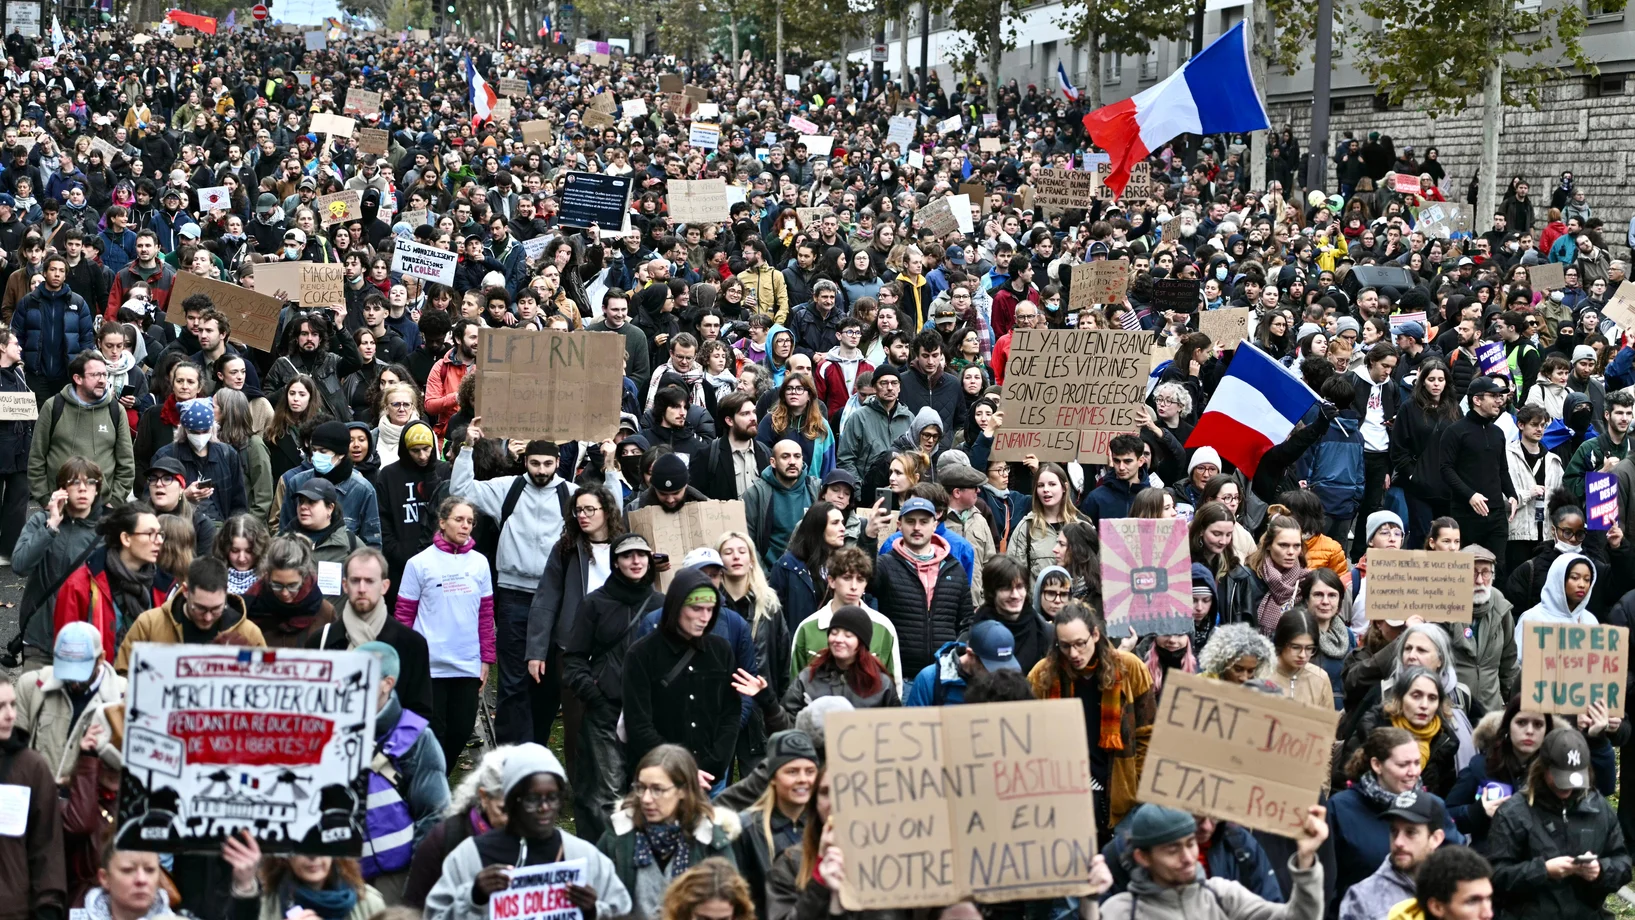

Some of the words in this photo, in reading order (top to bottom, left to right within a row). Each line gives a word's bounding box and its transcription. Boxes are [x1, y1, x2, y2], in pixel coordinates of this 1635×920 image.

[1045, 187, 1069, 195] FRANCE
[396, 240, 411, 251] ILS
[413, 247, 455, 261] MONDIALISENT
[402, 255, 443, 268] MONDIALISONS
[402, 263, 413, 272] LA
[414, 265, 440, 277] COLÈRE
[549, 335, 585, 369] RN
[1012, 331, 1034, 351] IL
[1064, 332, 1108, 355] QU'EN
[1480, 344, 1501, 362] BAISSE
[1010, 356, 1039, 376] QUE
[1044, 356, 1070, 378] LES
[1076, 356, 1140, 379] VITRINES
[1490, 352, 1501, 364] DES
[1005, 382, 1046, 400] SONT
[1020, 406, 1046, 425] LES
[1110, 408, 1132, 426] LES
[995, 432, 1046, 450] ENFANTS,
[1047, 432, 1074, 450] LES
[1589, 477, 1610, 494] BAISSE
[1600, 488, 1610, 501] DES
[1423, 587, 1443, 598] laquelle
[1371, 601, 1400, 610] cherchent
[1533, 626, 1619, 651] TIRER
[1545, 655, 1584, 670] N'EST
[1588, 652, 1619, 674] PAS
[162, 682, 214, 710] MERCI
[1532, 681, 1619, 709] JUGER
[168, 713, 232, 733] PENDANT
[233, 714, 249, 730] LA
[1167, 685, 1249, 741] ETAT
[188, 737, 203, 752] DE
[208, 738, 233, 751] VOS
[837, 721, 943, 764] C'EST
[970, 714, 1032, 759] EN
[832, 763, 985, 813] PRENANT
[992, 758, 1090, 796] BASTILLE
[1150, 758, 1234, 809] ETAT
[850, 815, 934, 848] QU'ON
[966, 810, 985, 834] A
[1011, 804, 1056, 830] EU
[858, 849, 954, 892] NOTRE
[970, 837, 1093, 886] NATION
[512, 870, 580, 889] CRIMINALISENT
[494, 894, 519, 919] NOS
[524, 886, 578, 914] COLÈRE
